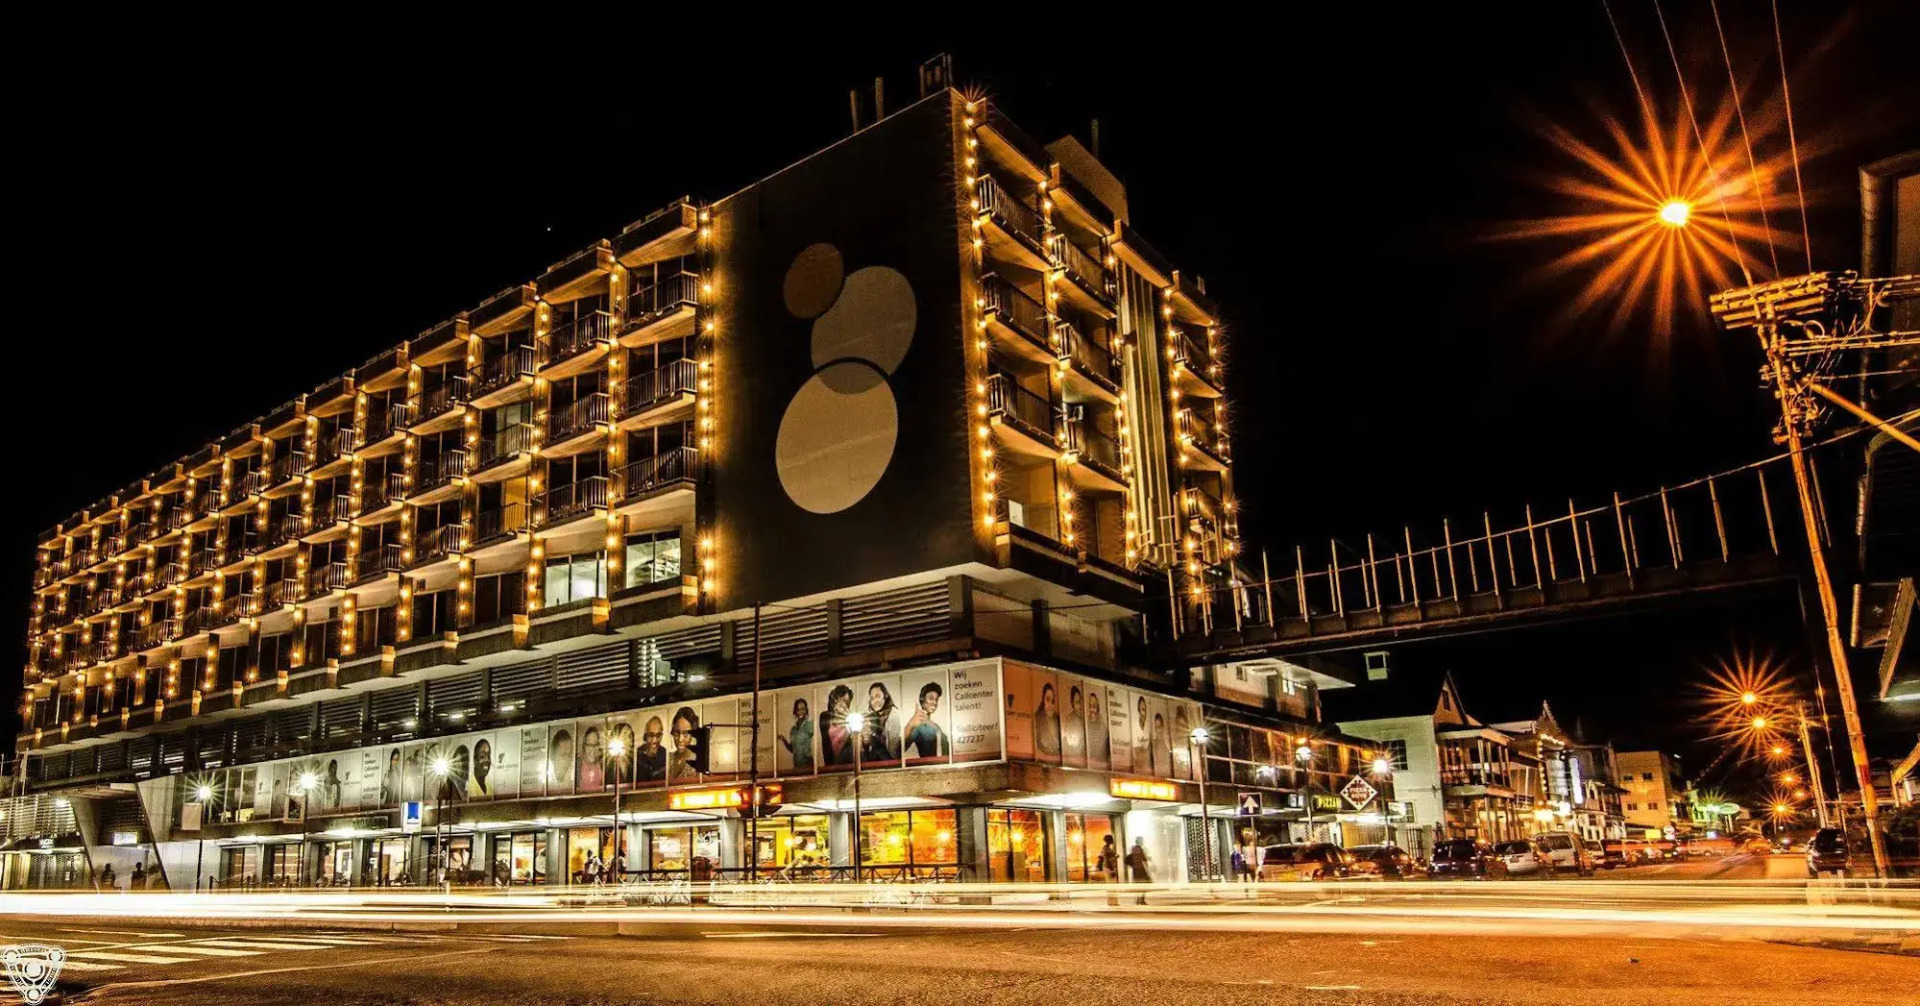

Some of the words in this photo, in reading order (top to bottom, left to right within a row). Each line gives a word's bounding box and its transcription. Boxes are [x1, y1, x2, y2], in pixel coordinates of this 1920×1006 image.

[954, 671, 967, 680] Wij
[954, 681, 983, 690] zoeken
[954, 690, 994, 701] Callcenter
